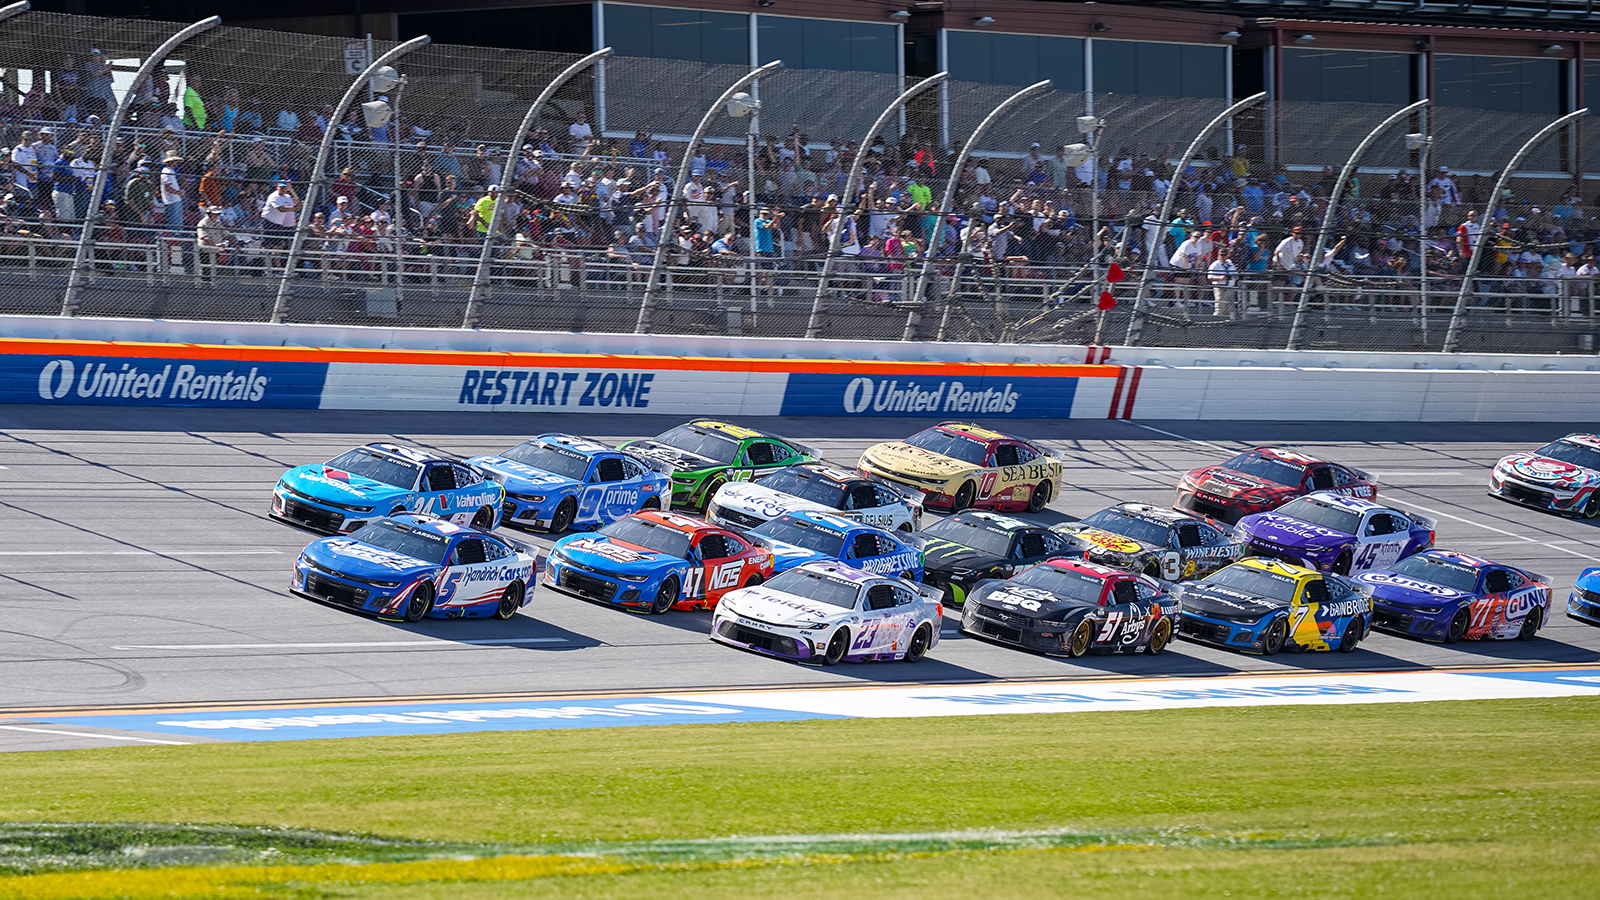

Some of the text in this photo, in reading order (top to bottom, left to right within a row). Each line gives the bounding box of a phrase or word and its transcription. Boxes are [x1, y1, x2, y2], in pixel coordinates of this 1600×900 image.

[77, 363, 267, 401] United Rentals
[459, 370, 655, 408] RESTART ZONE
[873, 380, 1019, 413] United Rentals
[387, 457, 411, 468] BYRON
[558, 449, 584, 460] ELLIOTT
[819, 478, 841, 488] PREECE
[1002, 462, 1059, 482] SEA BEST
[299, 471, 367, 498] Valvoline
[977, 470, 999, 500] 10
[1354, 485, 1372, 498] TREE
[414, 492, 496, 514] 24 Valvoline
[577, 486, 638, 519] 9 prime
[743, 496, 790, 517] Krog
[1196, 492, 1226, 504] CAMRY
[865, 512, 893, 528] CELSIUS
[1143, 517, 1168, 528] DILLON
[1258, 519, 1316, 539] mobile
[412, 530, 442, 542] LARSON
[813, 525, 842, 538] HAMLIN
[1253, 540, 1284, 552] CAMRY
[1354, 540, 1402, 570] 45 xfinity
[862, 552, 919, 574] PROGRESSIVE
[1164, 551, 1181, 580] 3
[434, 564, 531, 607] 5 HendrickCars.com
[682, 567, 704, 598] 47
[708, 559, 745, 592] NOS
[826, 576, 857, 588] WALLACE
[1081, 574, 1100, 584] WARE
[1271, 574, 1295, 583] HALEY
[1372, 573, 1448, 596] GUNK
[761, 594, 827, 619] leidos
[987, 591, 1042, 613] BBQ
[1330, 597, 1370, 618] GAINBRIDGE
[1509, 588, 1546, 613] GUNK
[1290, 605, 1309, 637] 7
[1471, 598, 1492, 628] 71
[738, 617, 773, 632] CAMRY
[851, 617, 882, 650] 23
[1096, 611, 1123, 642] 51
